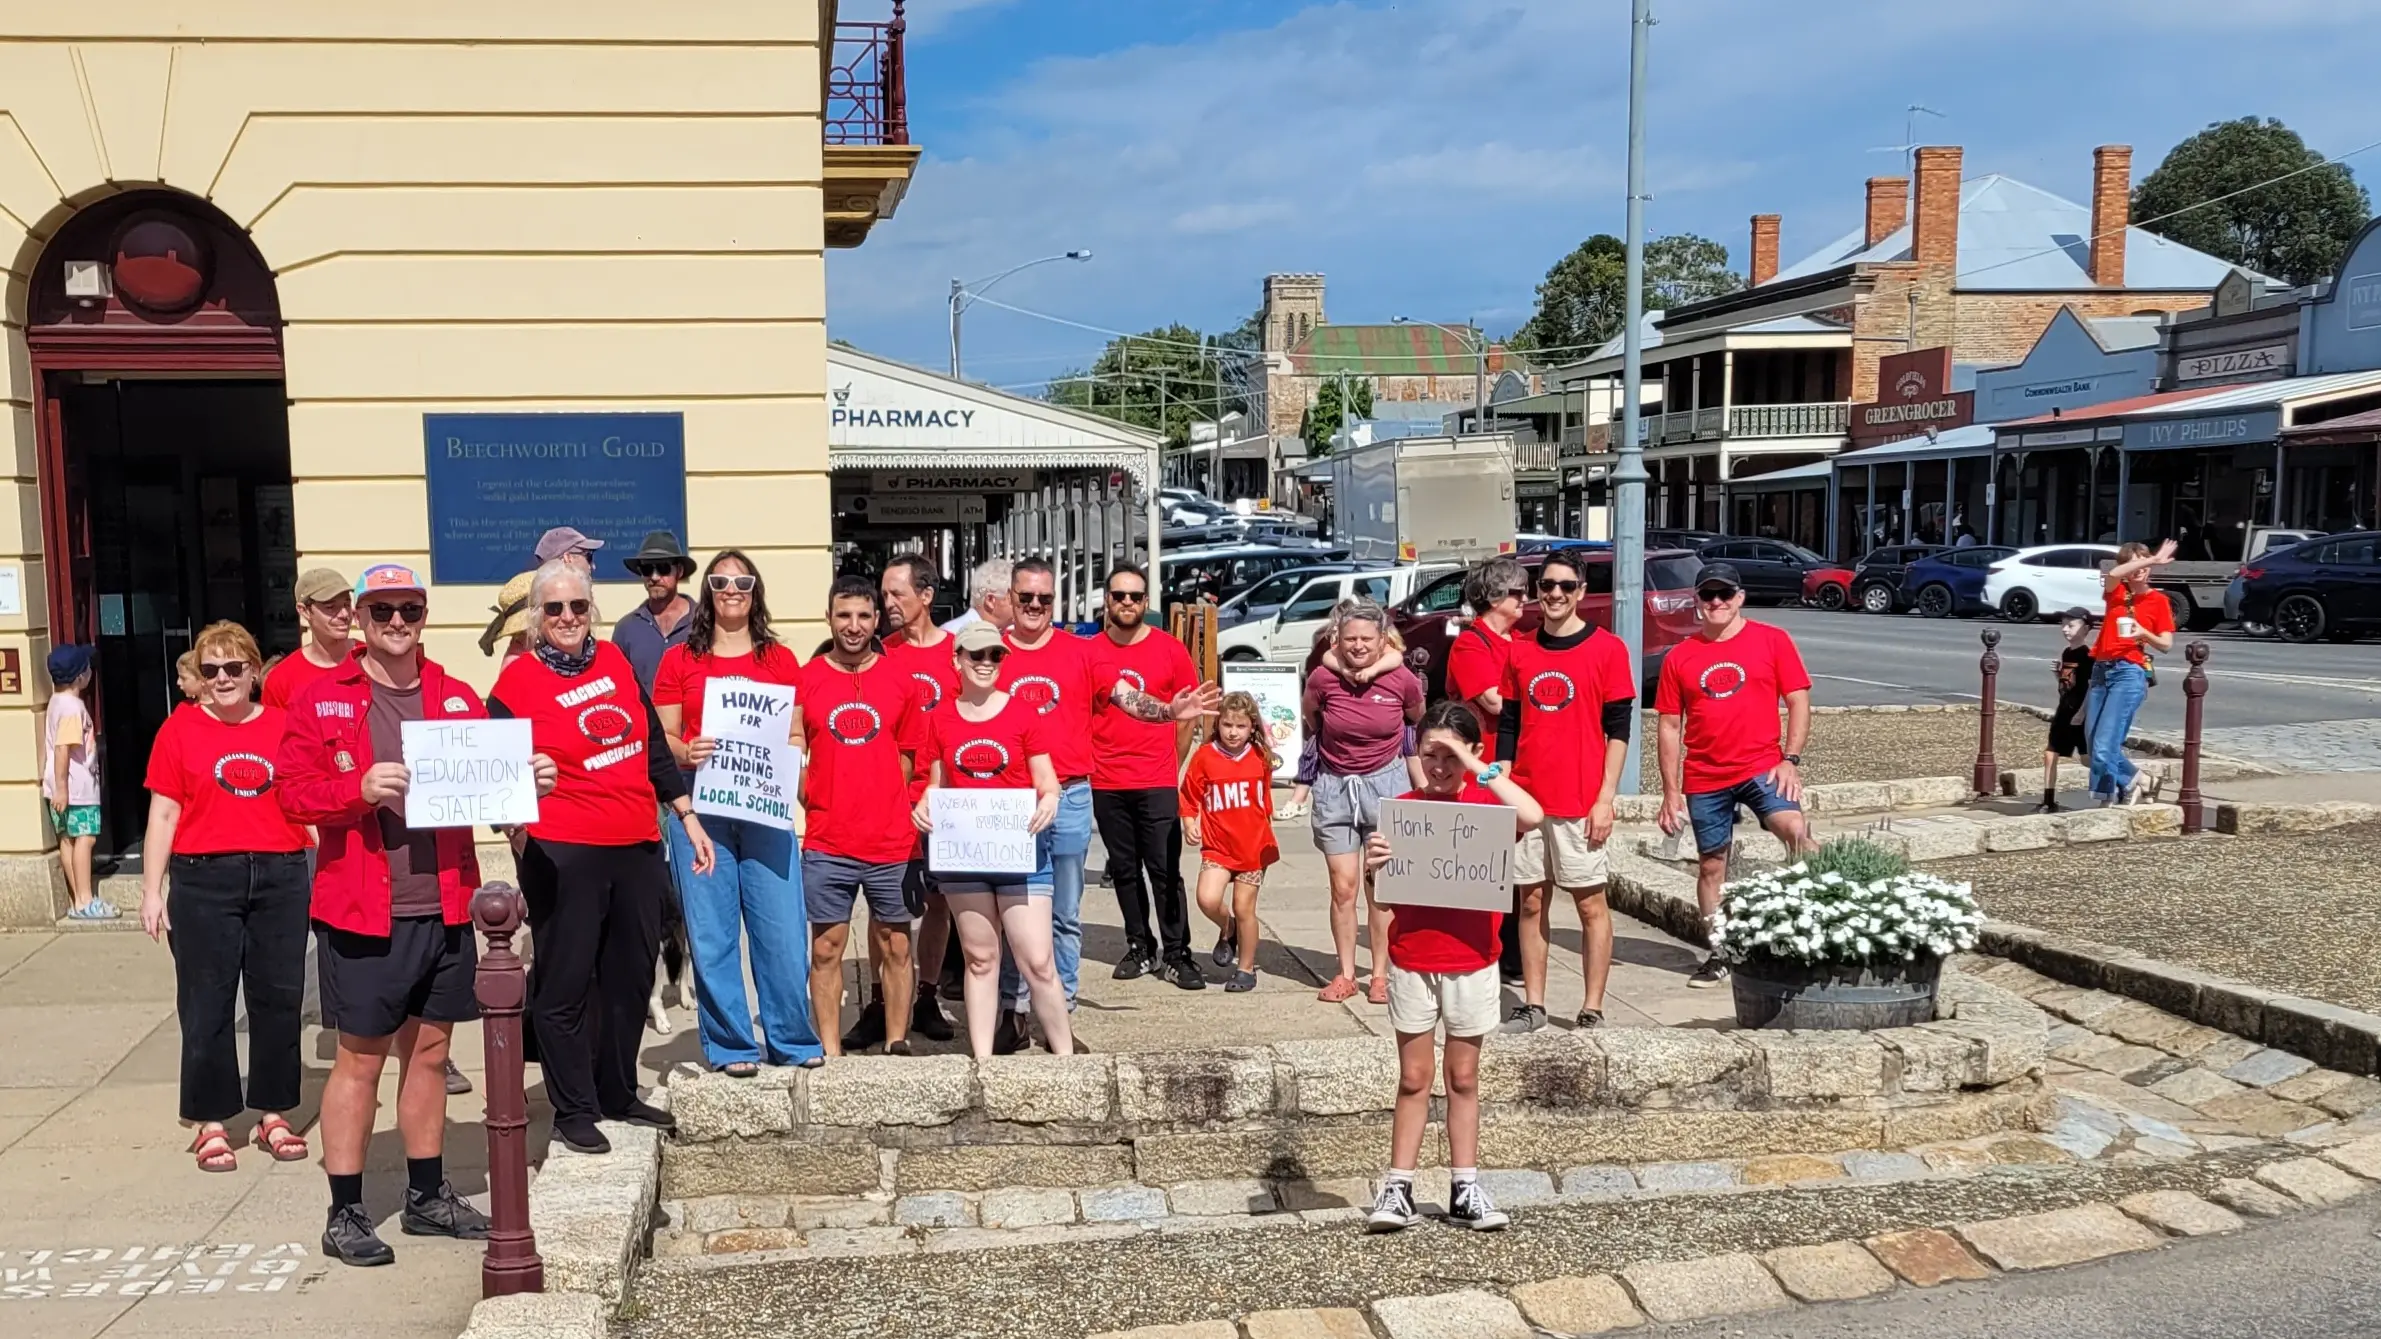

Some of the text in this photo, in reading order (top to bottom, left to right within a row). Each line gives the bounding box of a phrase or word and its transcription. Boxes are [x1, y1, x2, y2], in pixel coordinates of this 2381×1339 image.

[2190, 351, 2275, 377] PIZZA
[832, 409, 976, 428] PHARMACY
[1865, 399, 1957, 425] GREENGROCER
[2150, 418, 2248, 443] IVY PHILLIPS
[906, 477, 1020, 489] PHARMACY
[880, 506, 983, 516] BENDIGO BANK ATM
[555, 676, 616, 708] TEACHERS
[721, 691, 790, 717] HONK!
[740, 713, 762, 729] FOR
[428, 726, 478, 749] THE
[583, 740, 643, 771] PRINCIPALS
[714, 738, 771, 762] BETTER
[415, 757, 520, 785] EDUCATION
[234, 788, 258, 798] UNION
[734, 774, 783, 798] FOR YOUR
[428, 788, 514, 822] STATE?
[699, 786, 793, 821] LOCAL SCHOOL
[937, 797, 978, 811] WEAR
[976, 814, 1030, 831] PUBLIC
[1392, 809, 1479, 849] Honk for
[937, 840, 1033, 862] EDUCATION!
[1386, 857, 1415, 878] our
[0, 1242, 309, 1266] VEHICL
